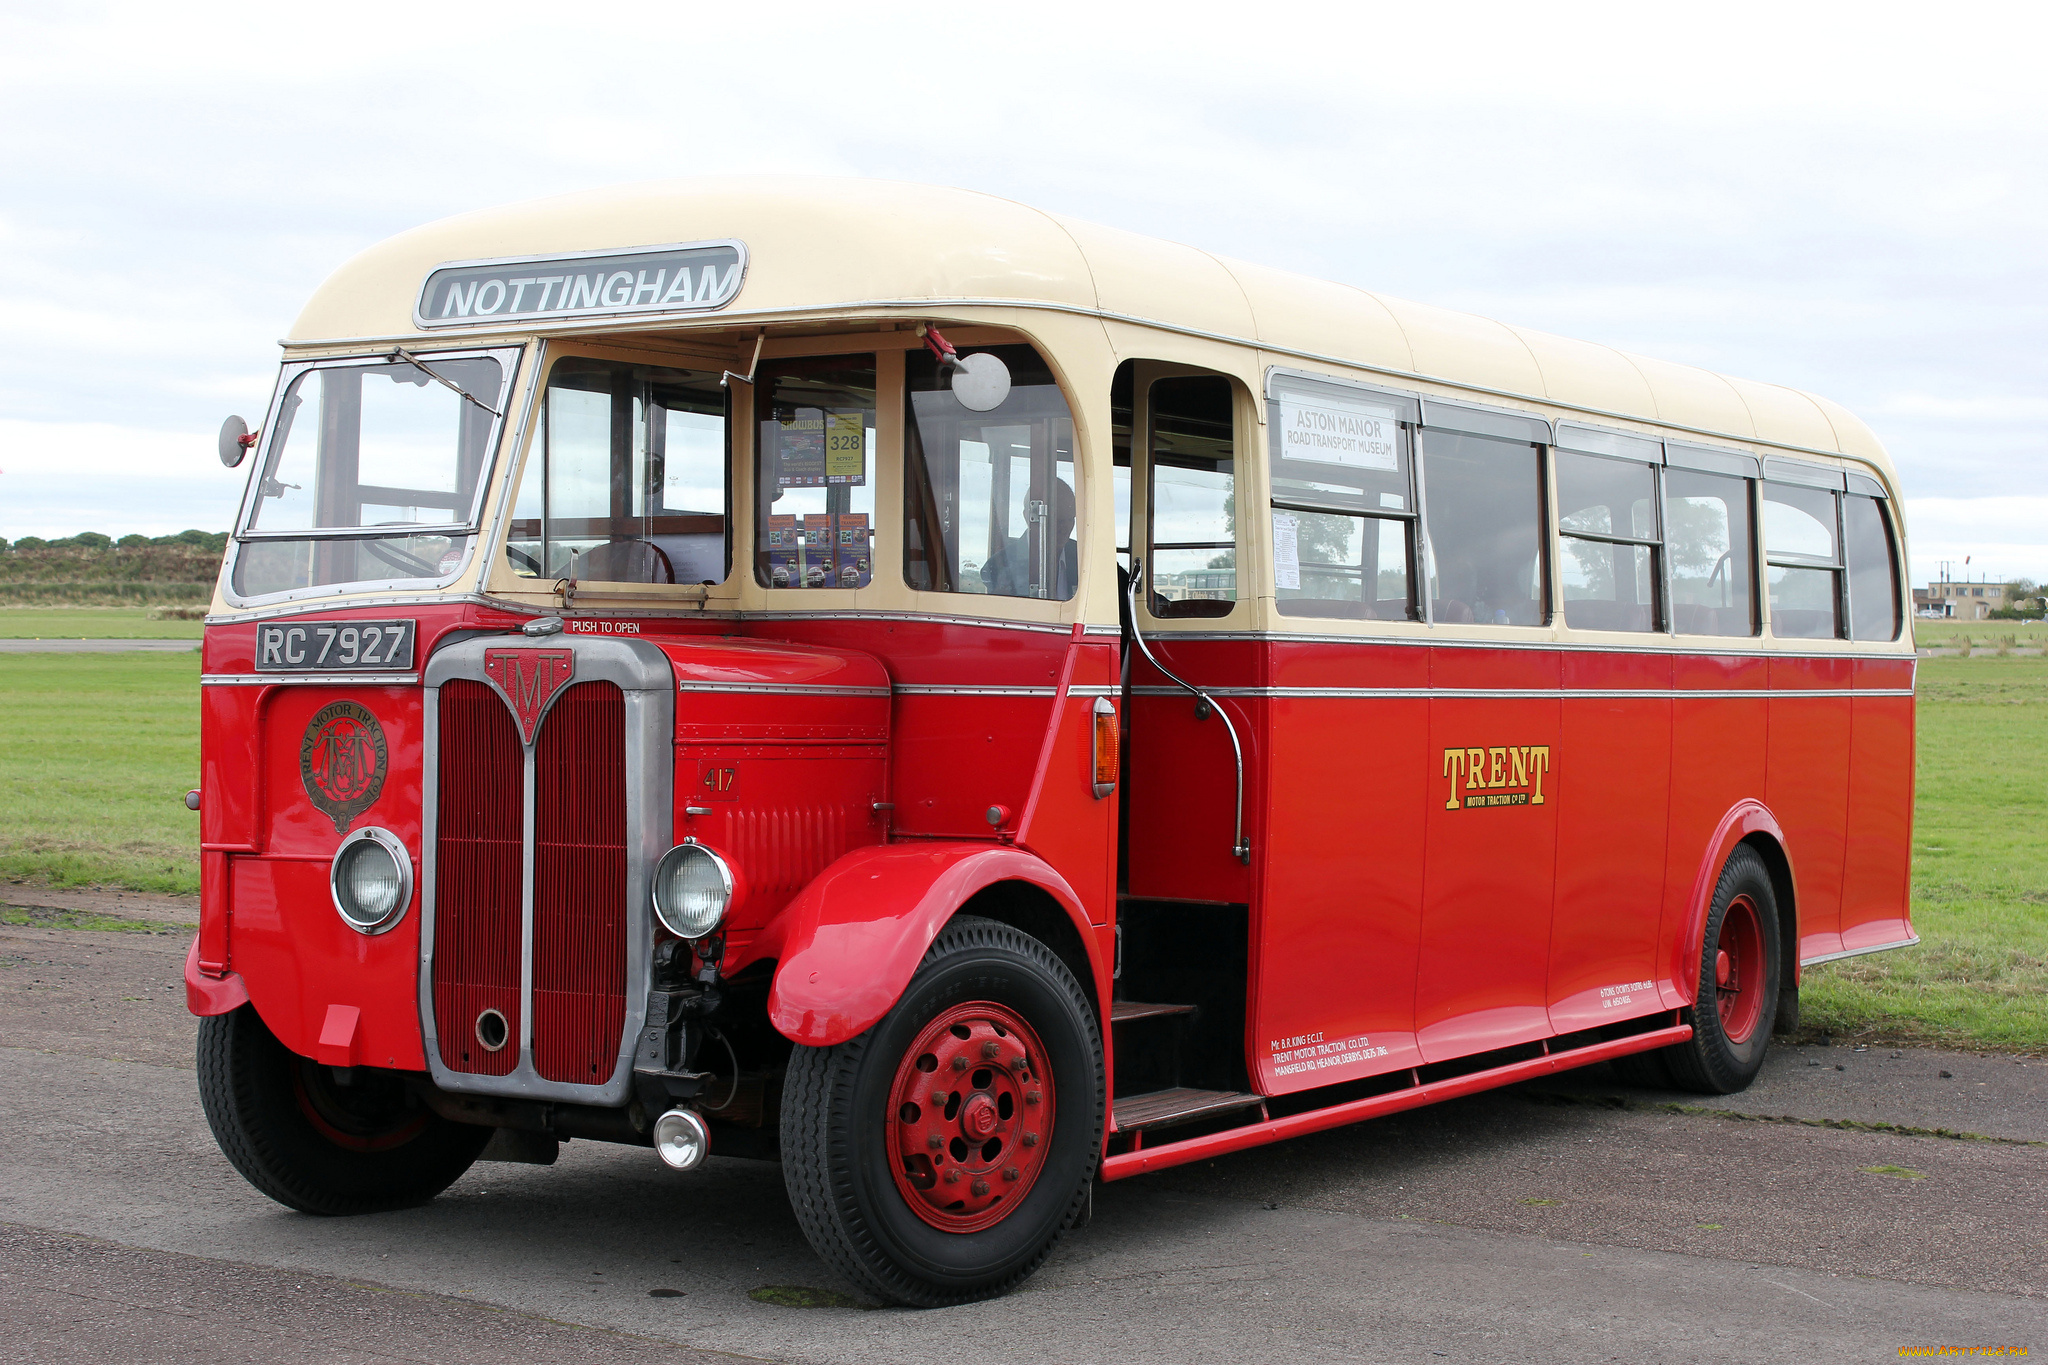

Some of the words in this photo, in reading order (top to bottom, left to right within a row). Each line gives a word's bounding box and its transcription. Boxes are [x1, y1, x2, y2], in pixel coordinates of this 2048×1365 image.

[441, 263, 738, 318] NOTTINGHAM
[1297, 410, 1336, 432] ASTON
[1338, 416, 1382, 438] MANOR
[830, 435, 860, 451] 328
[1287, 430, 1311, 446] ROAD
[1311, 433, 1356, 451] TRANSPORT
[1359, 441, 1392, 456] MUSEUM
[572, 620, 598, 632] PUSH
[599, 621, 613, 633] TO
[614, 622, 640, 634] OPEN
[263, 628, 306, 664] RC
[316, 626, 406, 664] 7927
[312, 704, 351, 732] MOTOR
[357, 706, 386, 770] TRACTION
[703, 768, 735, 791] 417
[1443, 745, 1550, 811] TRENT
[1467, 796, 1486, 807] MOTOR
[1487, 793, 1511, 806] TRACTION
[1272, 1051, 1293, 1064] TRENT
[1293, 1046, 1317, 1060] MOTOR
[1317, 1041, 1347, 1056] TRACTION
[1274, 1061, 1307, 1077] MANSFIELD
